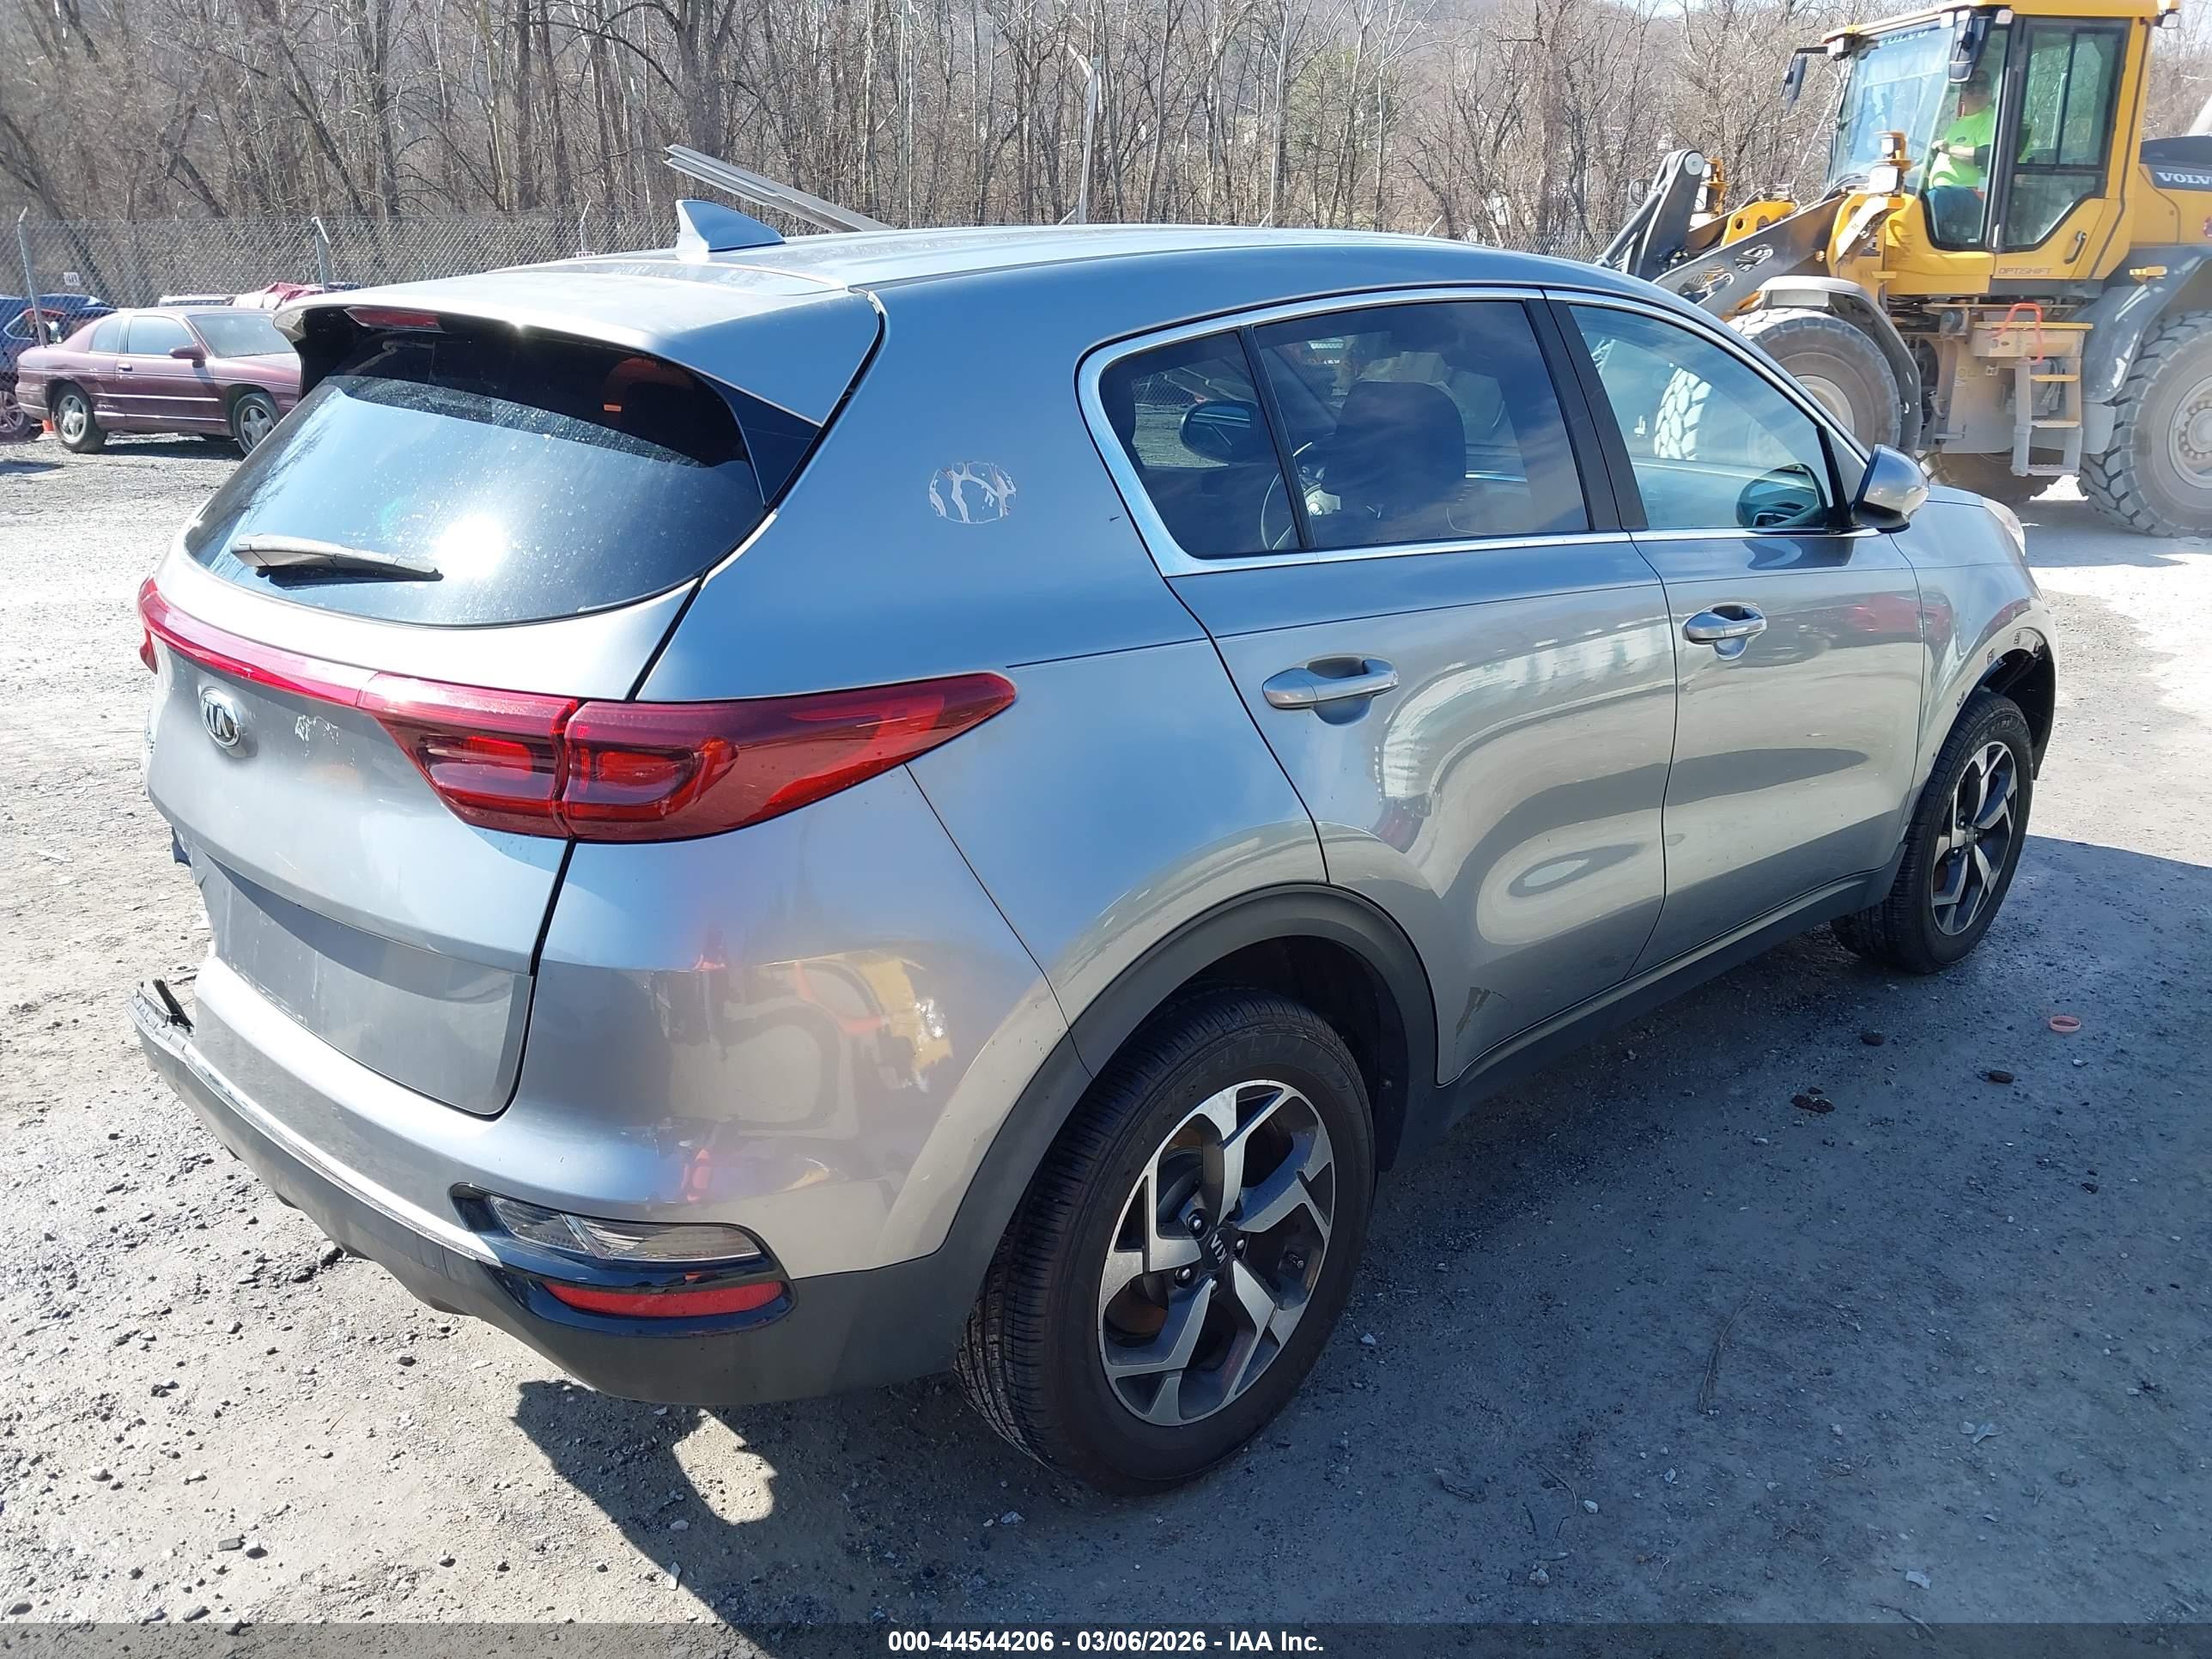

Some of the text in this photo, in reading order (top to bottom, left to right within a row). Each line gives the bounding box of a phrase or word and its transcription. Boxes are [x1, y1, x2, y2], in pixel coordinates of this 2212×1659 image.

[2155, 172, 2212, 185] VOLV
[201, 698, 230, 738] KIA
[1211, 1233, 1228, 1264] KIA
